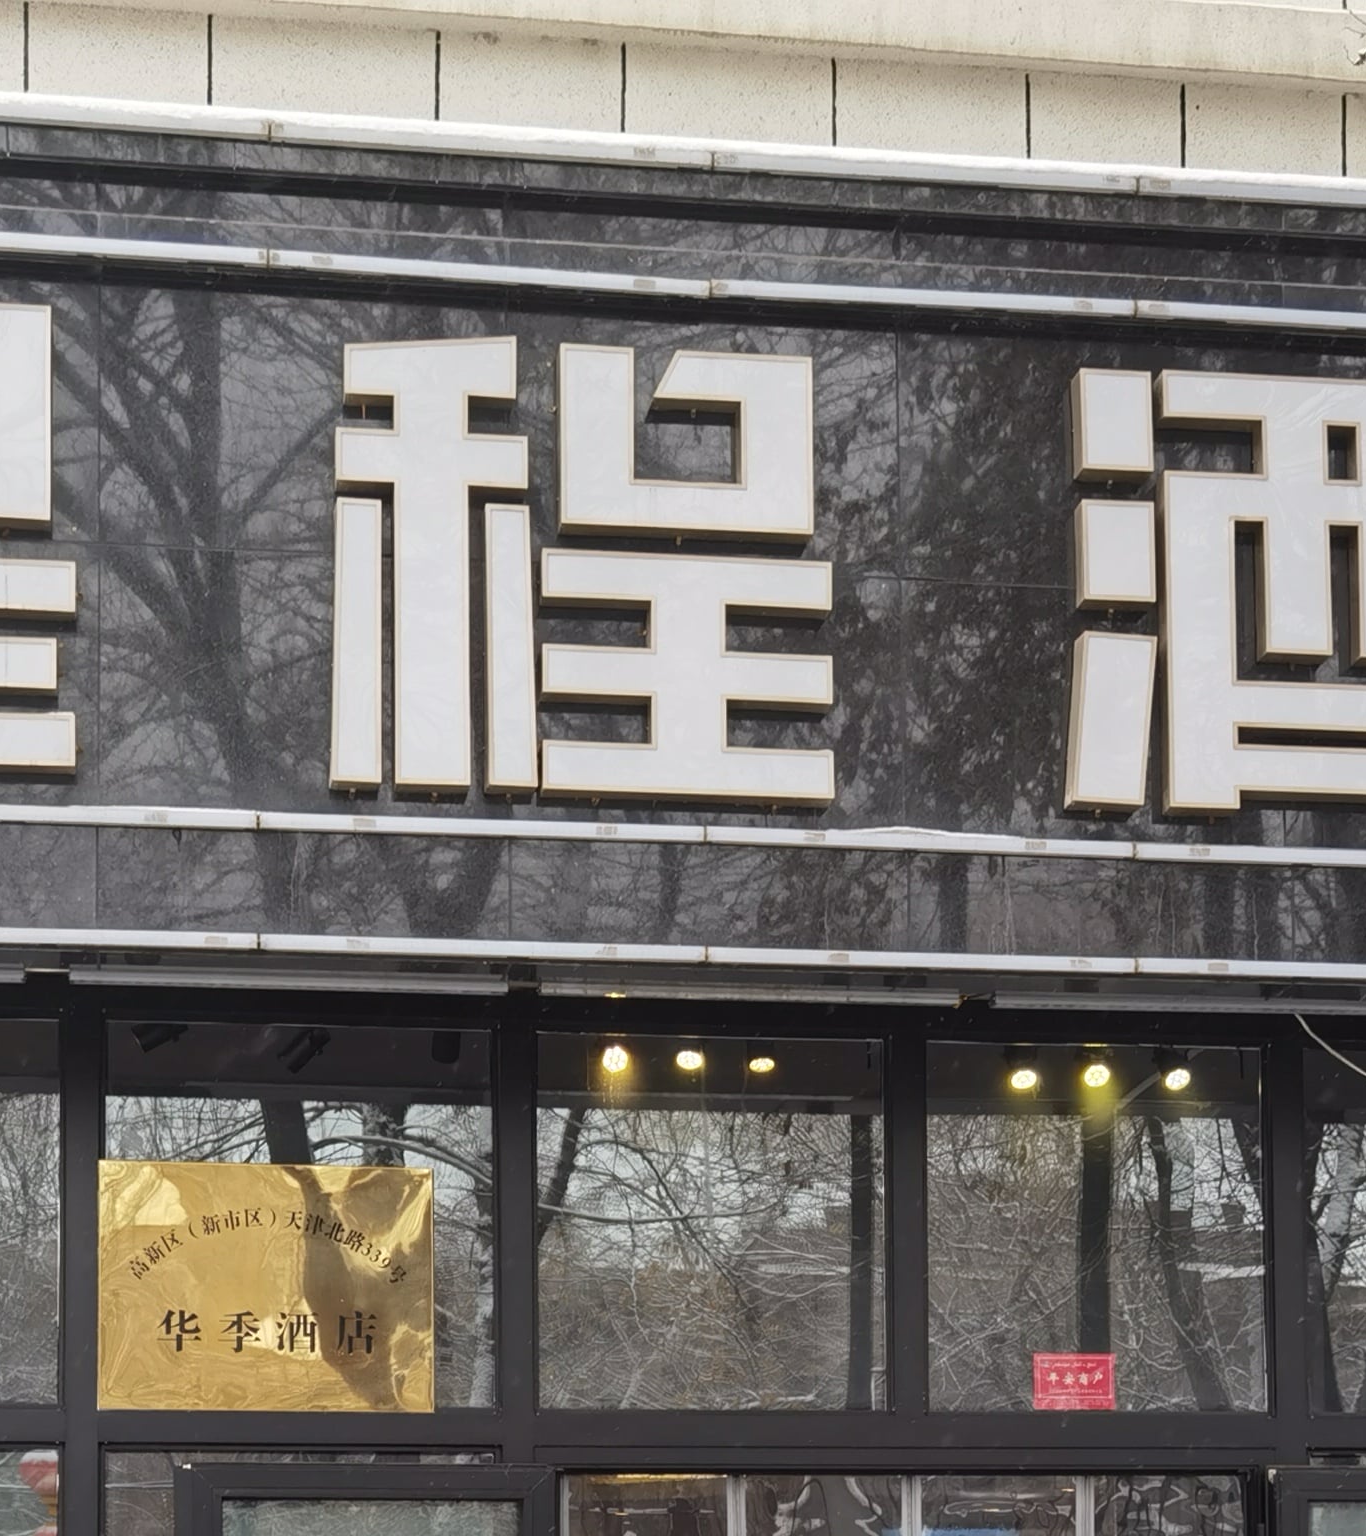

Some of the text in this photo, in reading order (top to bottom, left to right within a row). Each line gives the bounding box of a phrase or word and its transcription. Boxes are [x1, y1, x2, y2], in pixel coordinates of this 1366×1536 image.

[130, 1207, 407, 1285] 高新区（新市区）天津北路339号
[156, 1308, 377, 1355] 华季酒店
